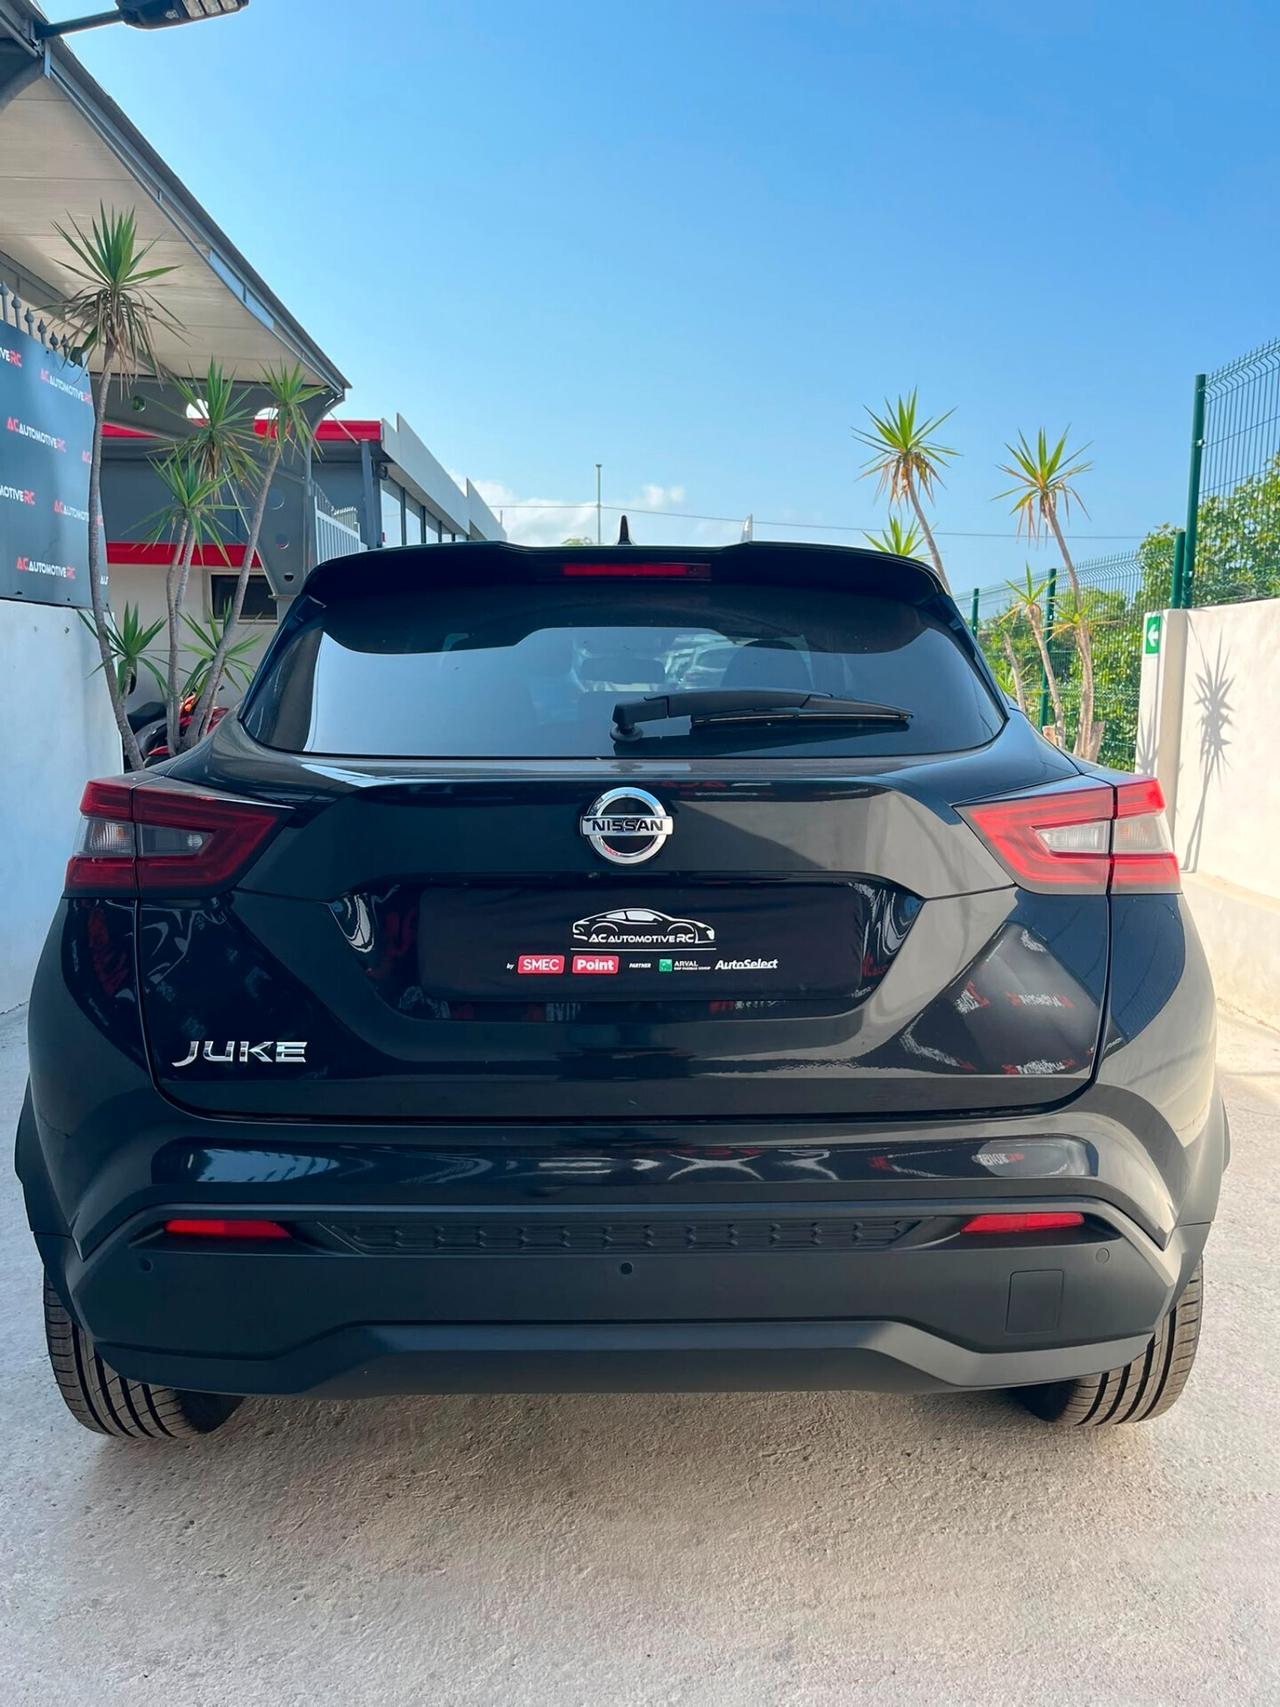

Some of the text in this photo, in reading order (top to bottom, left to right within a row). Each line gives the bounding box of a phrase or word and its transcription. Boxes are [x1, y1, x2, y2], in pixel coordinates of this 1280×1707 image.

[592, 819, 663, 832] NISSAN
[506, 962, 515, 970] by
[523, 959, 560, 971] SMEC
[576, 959, 615, 971] Point
[714, 958, 779, 971] AutoSelect
[171, 1041, 308, 1067] JUKE
